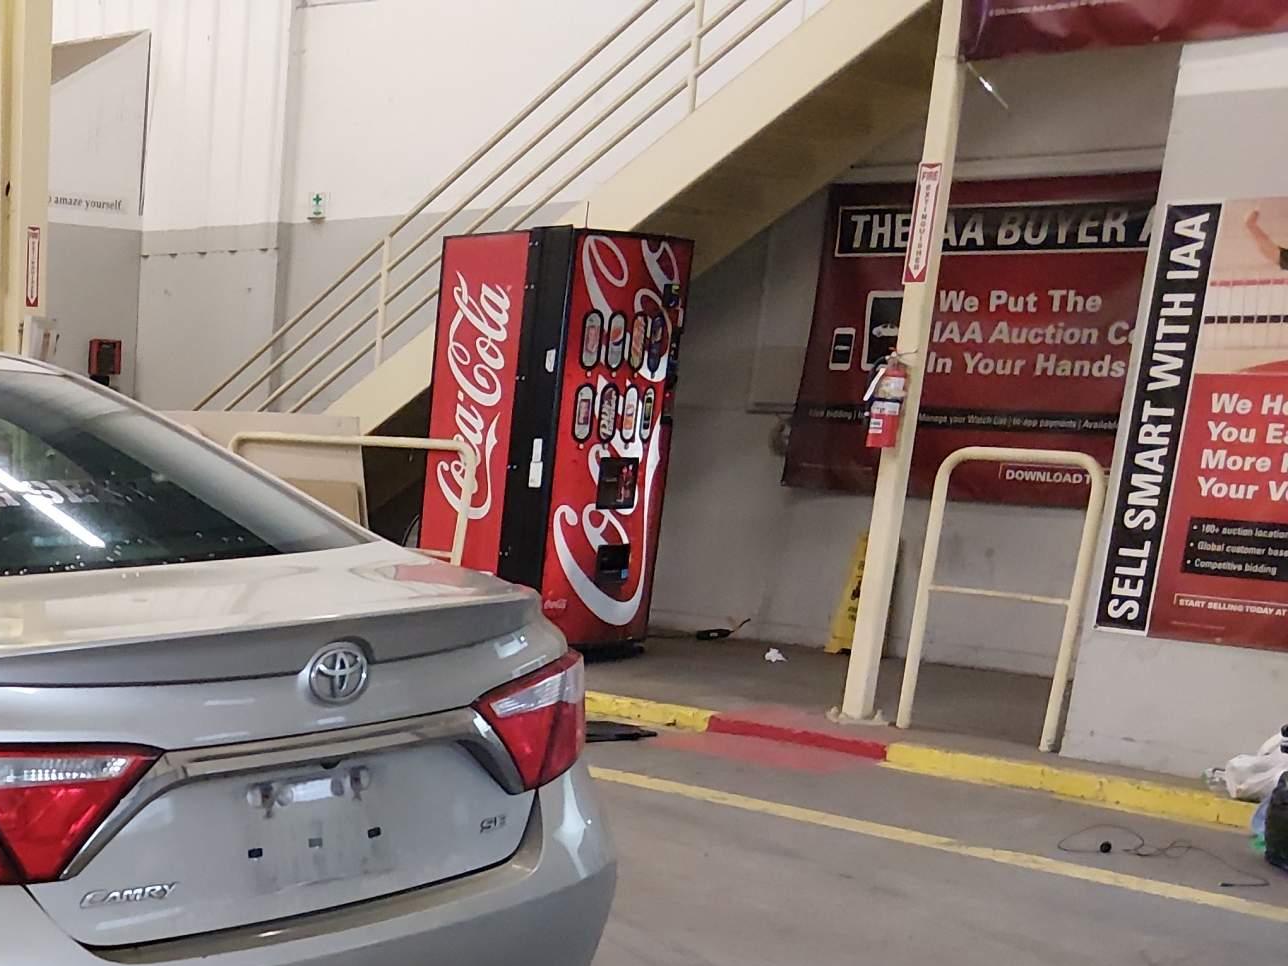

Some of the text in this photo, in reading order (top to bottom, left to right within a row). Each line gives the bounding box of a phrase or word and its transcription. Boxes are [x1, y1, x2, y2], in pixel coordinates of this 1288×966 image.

[851, 213, 912, 248] THE
[943, 212, 985, 247] AA
[997, 206, 1128, 246] BUYER
[939, 289, 1102, 313] We Put The
[932, 321, 983, 343] IAA
[989, 321, 1099, 345] Auction
[927, 352, 1126, 377] In Your Hands
[1107, 212, 1210, 620] SELL SMART WITH IAA
[1211, 393, 1253, 415] We
[1207, 420, 1256, 443] You
[1200, 448, 1272, 473] More
[1005, 469, 1083, 484] DOWNLOAD
[1197, 475, 1288, 501] Your V
[1221, 526, 1253, 537] auction
[1197, 541, 1225, 552] Global
[1226, 545, 1266, 556] customer
[1194, 558, 1277, 576] Competitive bidding
[1179, 598, 1288, 617] START SELLING TODAY AT
[79, 881, 179, 909] CAMRY
